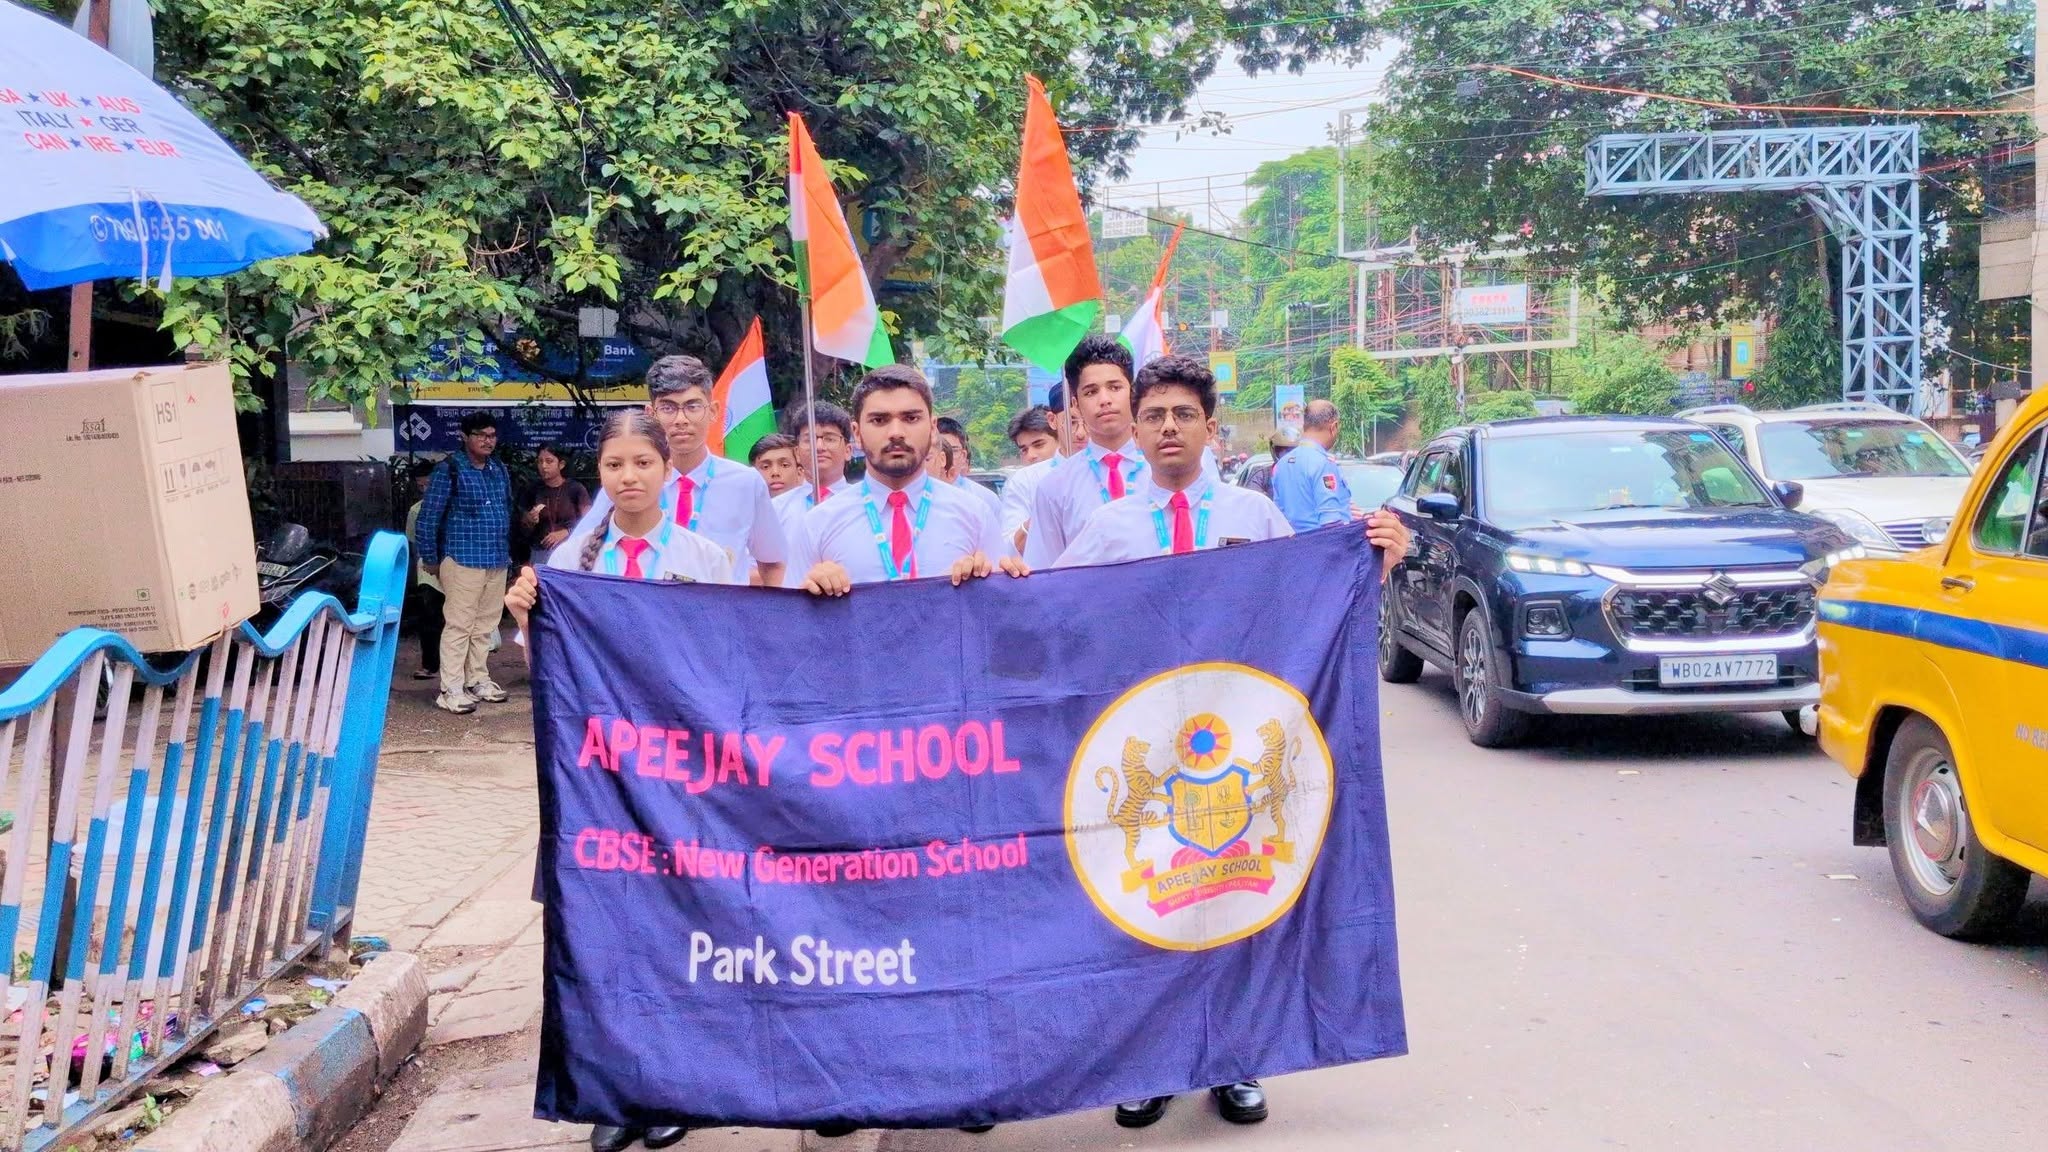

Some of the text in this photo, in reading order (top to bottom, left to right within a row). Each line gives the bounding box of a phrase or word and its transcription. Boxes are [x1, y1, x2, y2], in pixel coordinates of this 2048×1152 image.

[41, 90, 78, 109] UK
[96, 95, 141, 114] AUS
[16, 110, 144, 134] ITALY GER
[24, 132, 182, 158] CAN IRE EUR
[604, 344, 635, 356] Bank
[156, 402, 177, 425] HS1
[1671, 659, 1776, 679] WB02AV7772
[808, 720, 1021, 788] SCHOOL
[674, 839, 747, 880] New
[754, 845, 919, 883] Generation
[926, 832, 1029, 878] School
[1221, 858, 1262, 876] SCHOOL
[688, 931, 917, 986] Park Street
